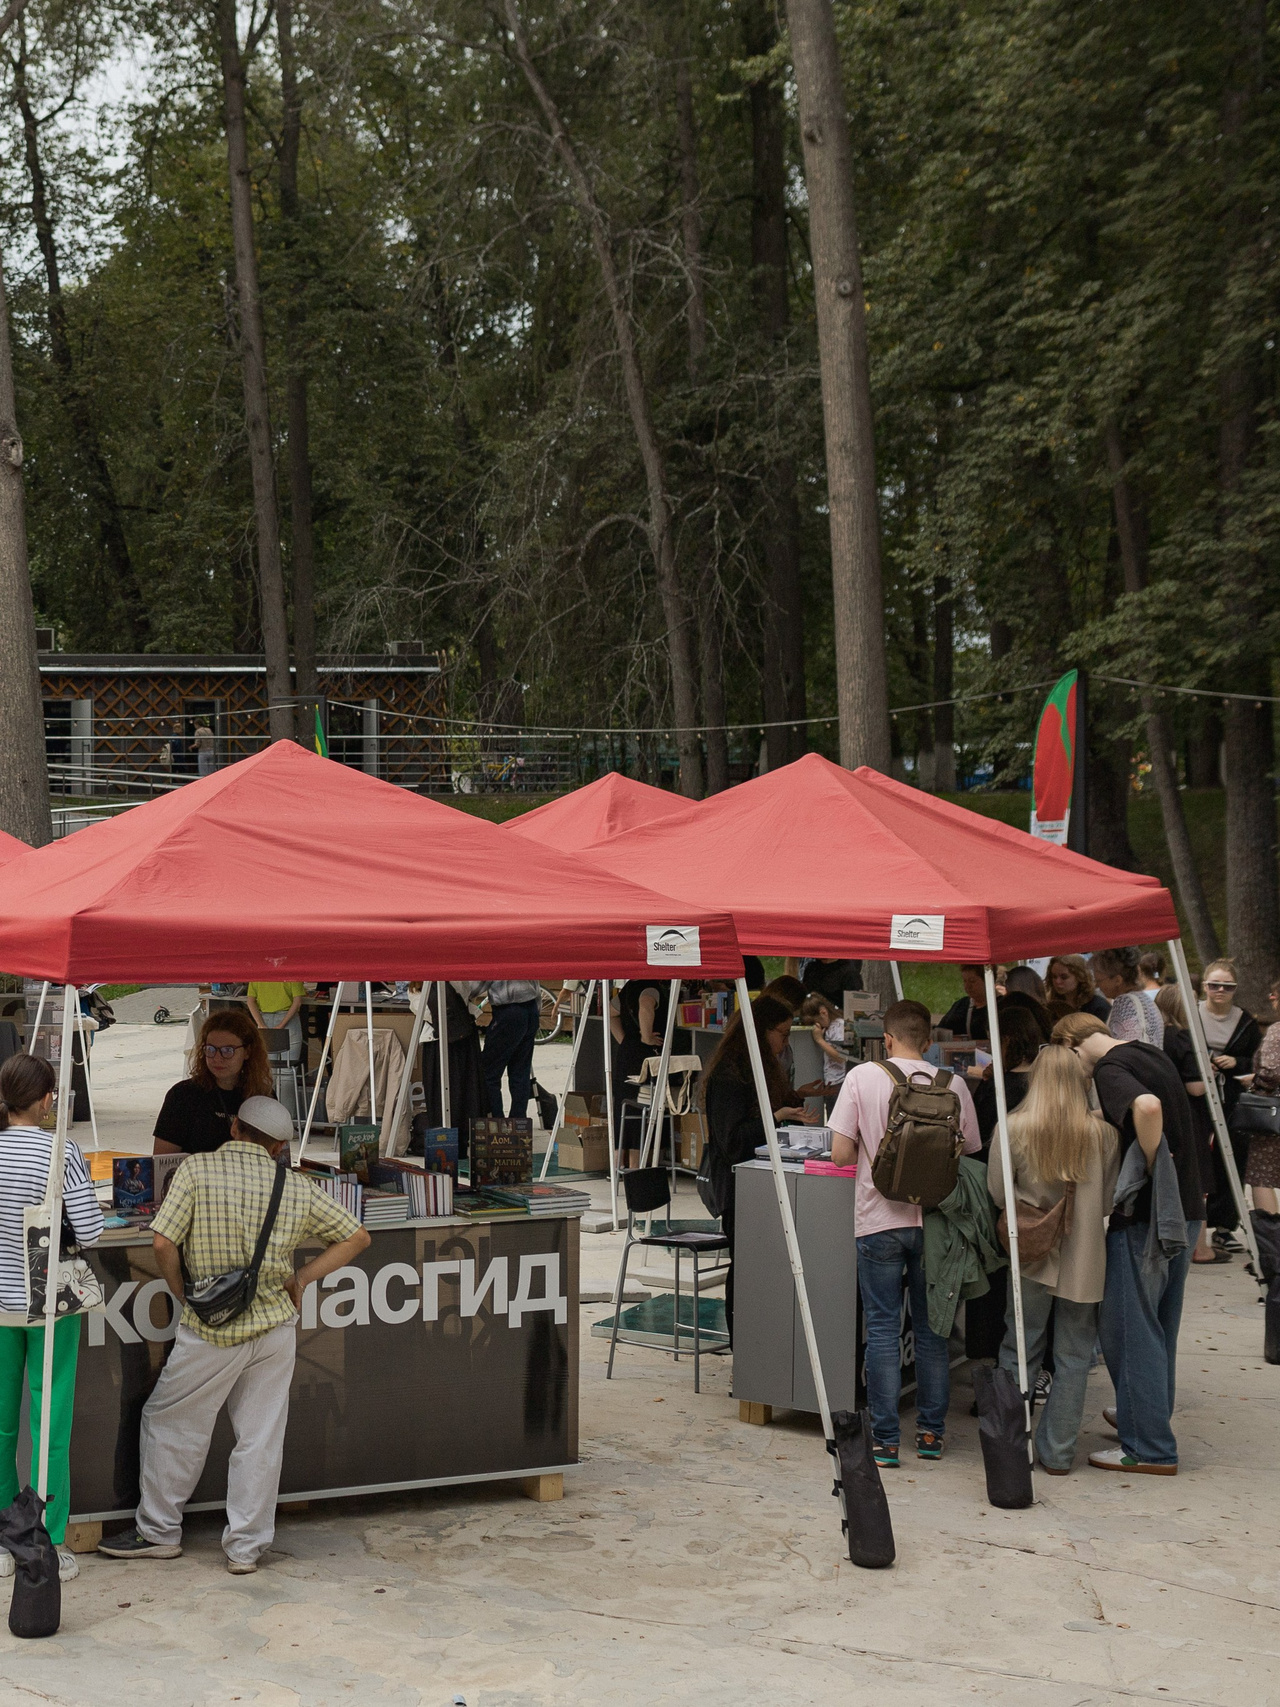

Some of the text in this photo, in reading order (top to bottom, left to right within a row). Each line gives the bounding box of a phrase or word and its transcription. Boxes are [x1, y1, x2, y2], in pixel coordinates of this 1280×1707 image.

[897, 929, 920, 938] Shelter
[653, 941, 676, 952] Shelter
[87, 1252, 568, 1347] коасгид
[209, 1308, 230, 1322] NIKE
